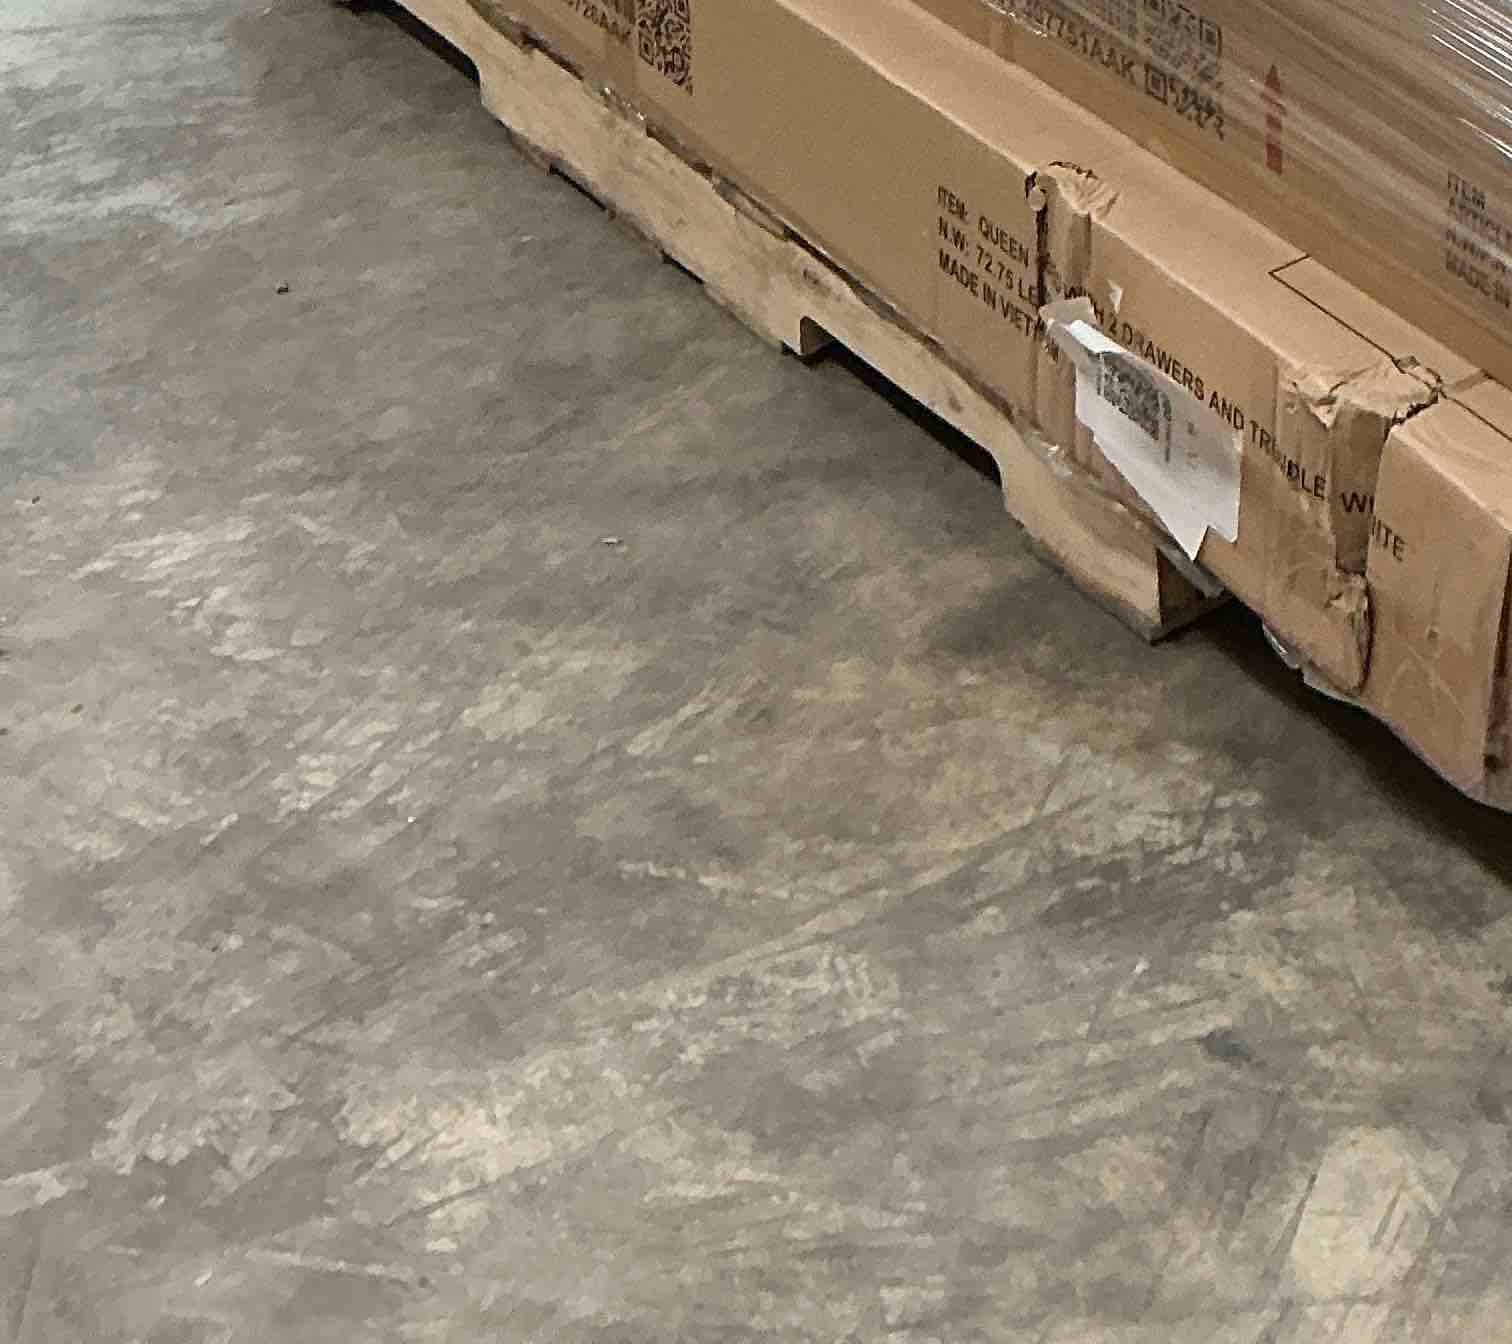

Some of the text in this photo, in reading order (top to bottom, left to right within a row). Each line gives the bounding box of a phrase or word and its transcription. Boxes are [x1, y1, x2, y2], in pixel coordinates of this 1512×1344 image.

[938, 247, 997, 310] MADE IN
[978, 215, 1029, 268] QUEEN
[1122, 324, 1206, 402] DRAWERS
[1208, 392, 1245, 431] AND
